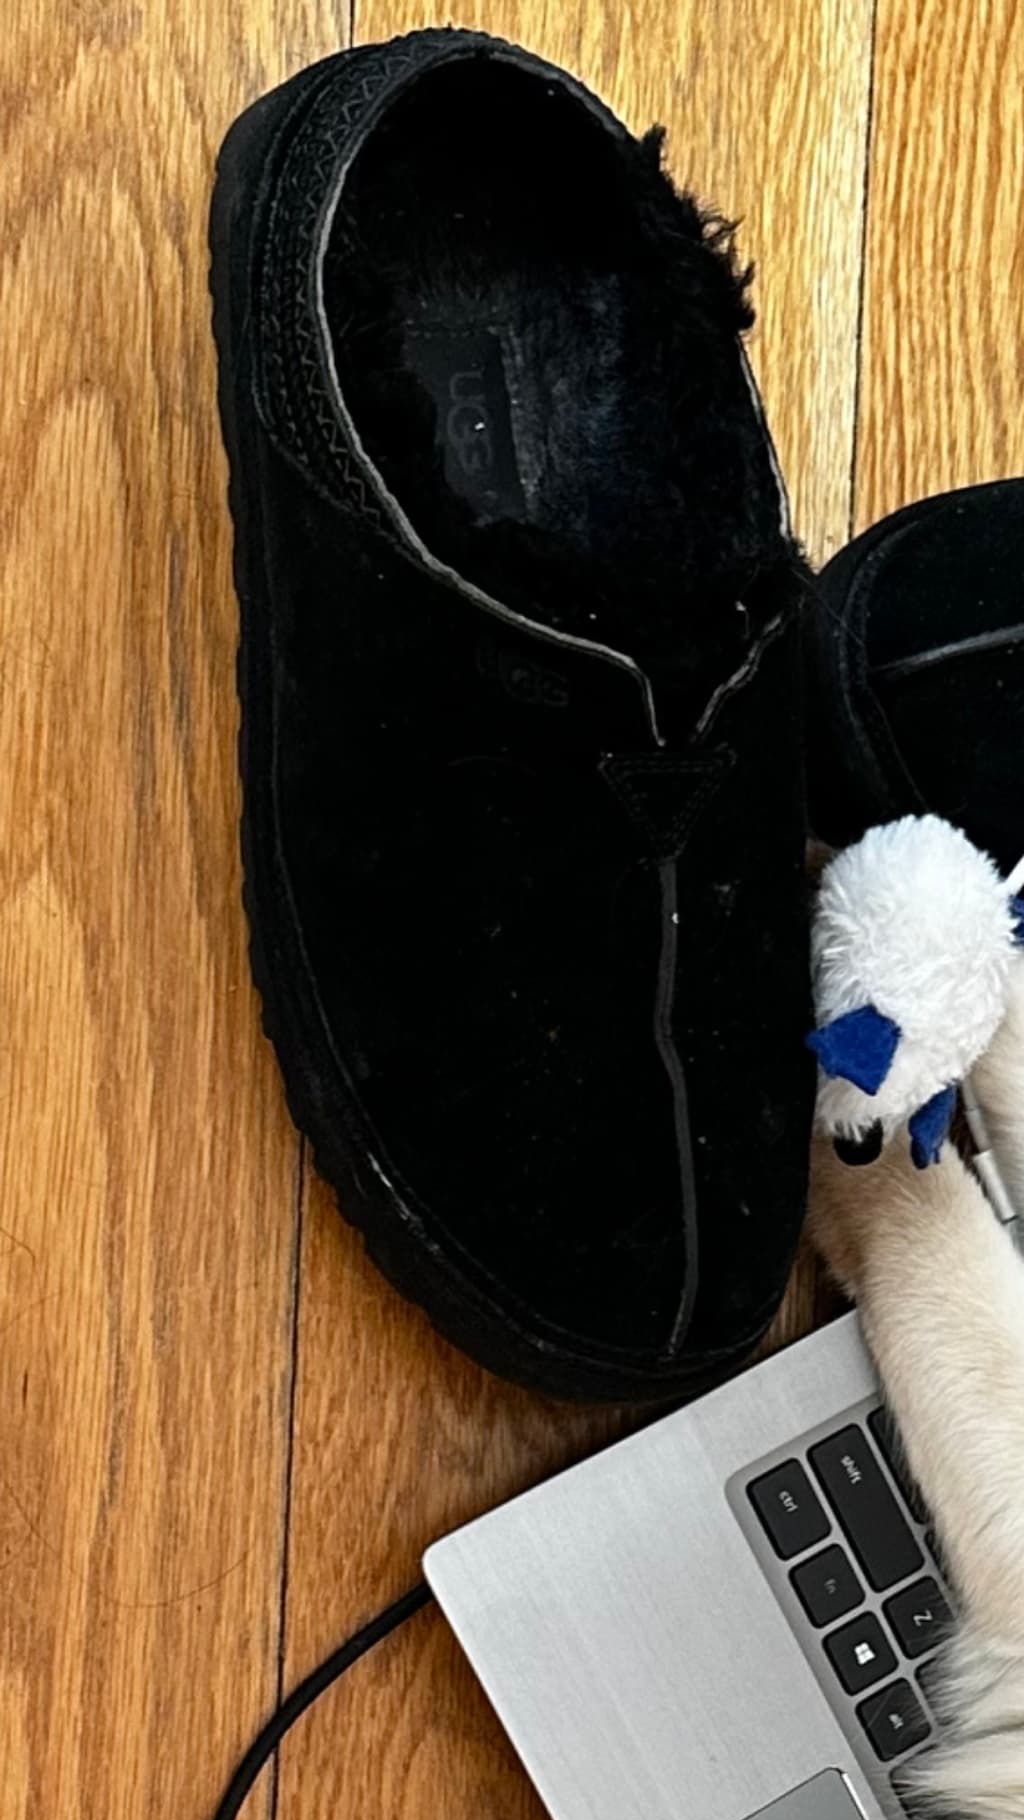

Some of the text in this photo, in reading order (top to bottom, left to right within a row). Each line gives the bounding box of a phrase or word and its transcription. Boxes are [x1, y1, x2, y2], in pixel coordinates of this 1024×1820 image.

[840, 1454, 863, 1485] shift
[778, 1490, 799, 1513] ctrl
[912, 1609, 933, 1627] Z
[888, 1713, 904, 1729] alt
